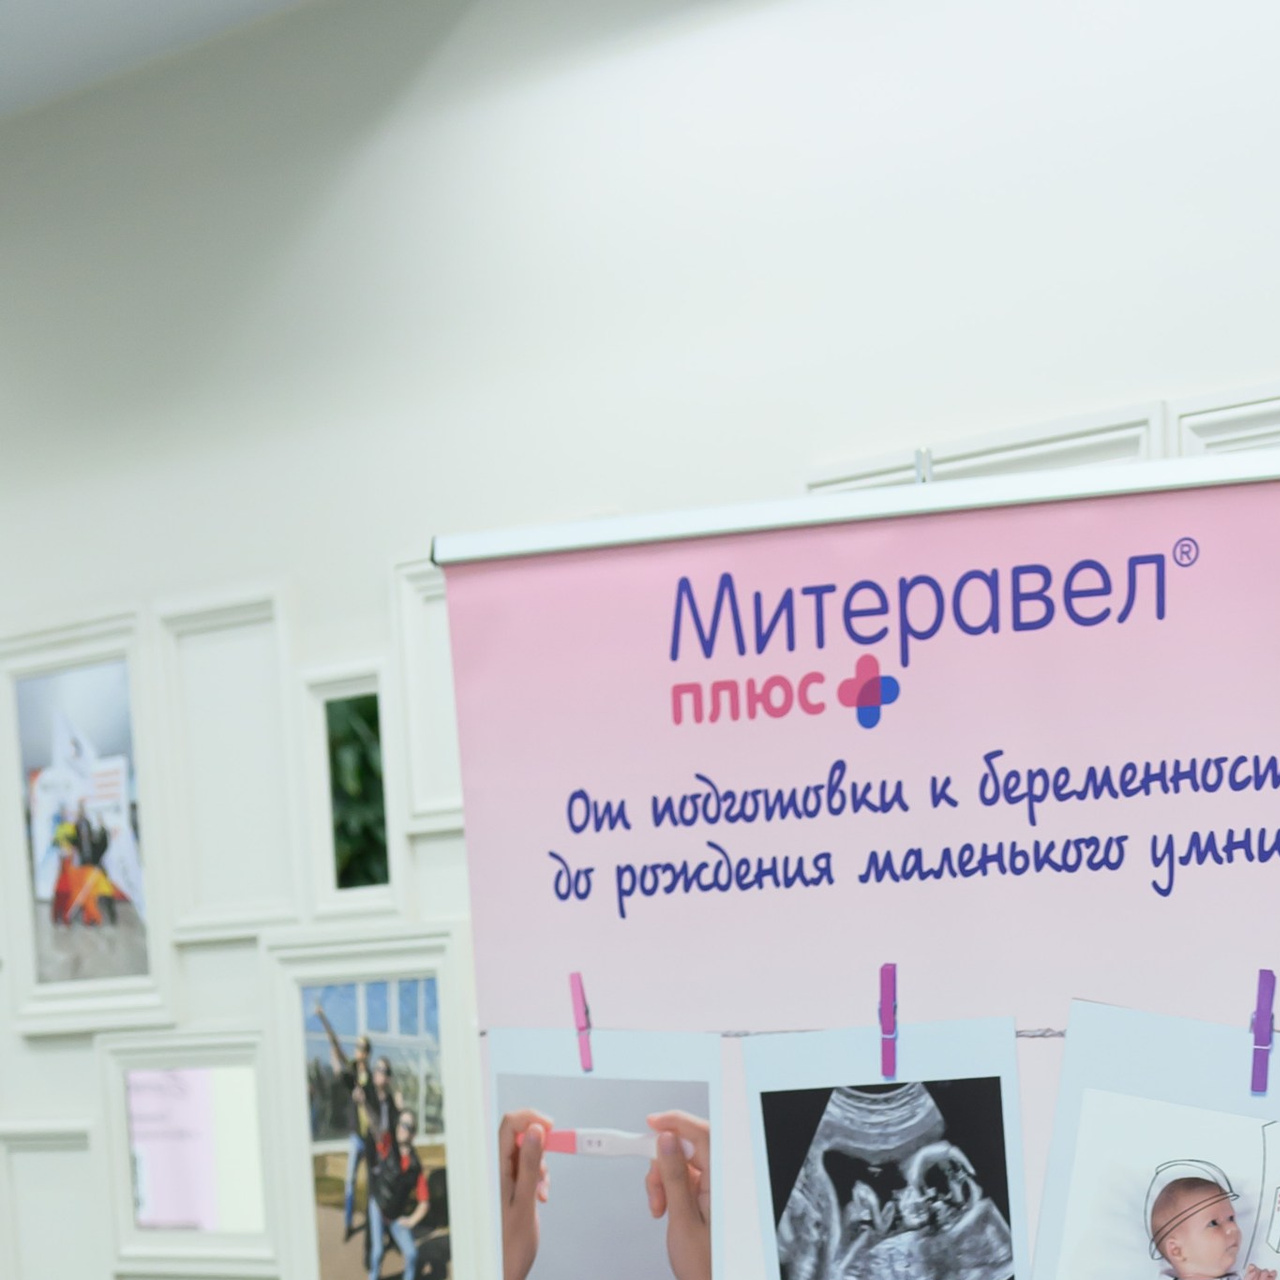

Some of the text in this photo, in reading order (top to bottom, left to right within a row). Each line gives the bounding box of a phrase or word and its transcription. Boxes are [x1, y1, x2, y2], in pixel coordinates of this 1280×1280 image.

[671, 671, 826, 726] плюс
[565, 789, 632, 834] От
[651, 759, 909, 829] подготовки
[931, 773, 958, 810] к
[549, 851, 593, 902] до
[615, 841, 835, 919] рождения
[858, 829, 1128, 887] маленького
